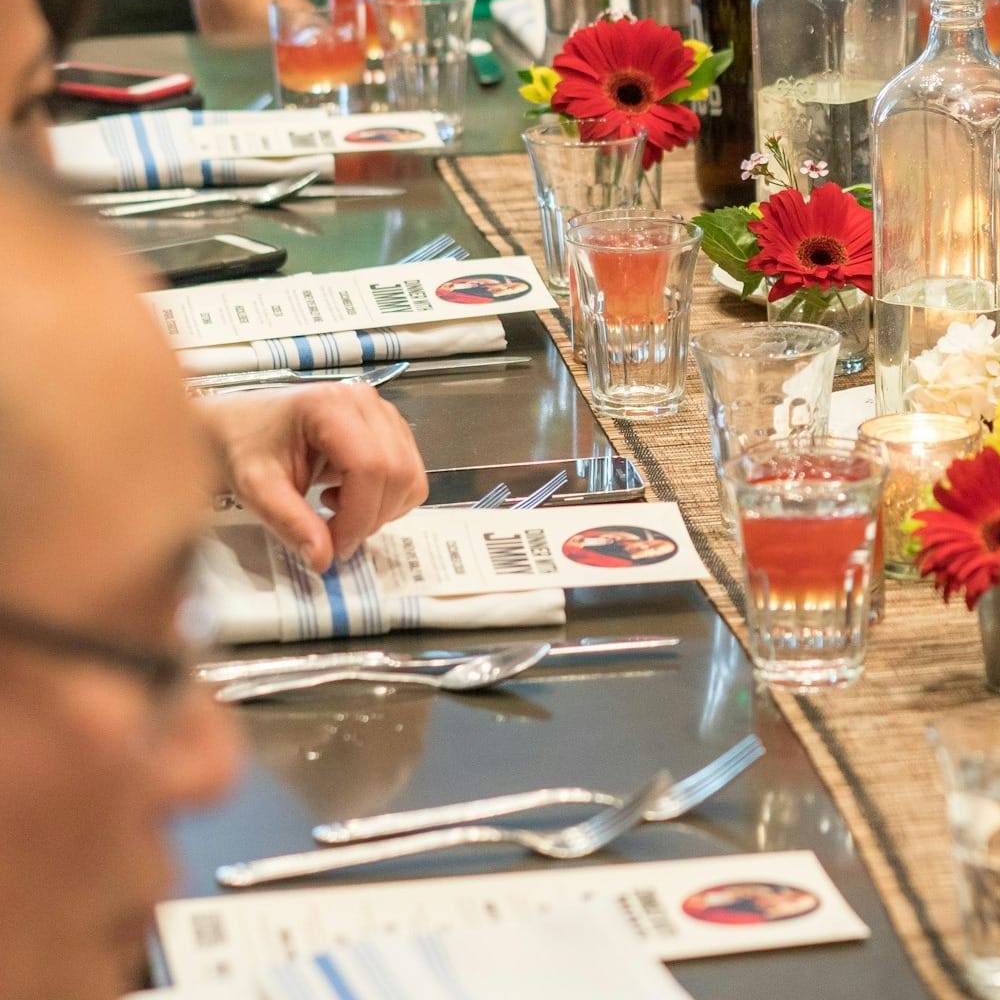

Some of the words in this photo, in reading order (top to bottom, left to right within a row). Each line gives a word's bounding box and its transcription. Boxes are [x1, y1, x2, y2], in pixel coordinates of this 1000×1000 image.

[369, 283, 413, 314] JIMMY
[403, 279, 428, 301] DINNER
[482, 532, 535, 576] JIMMY
[524, 528, 552, 557] DINNER
